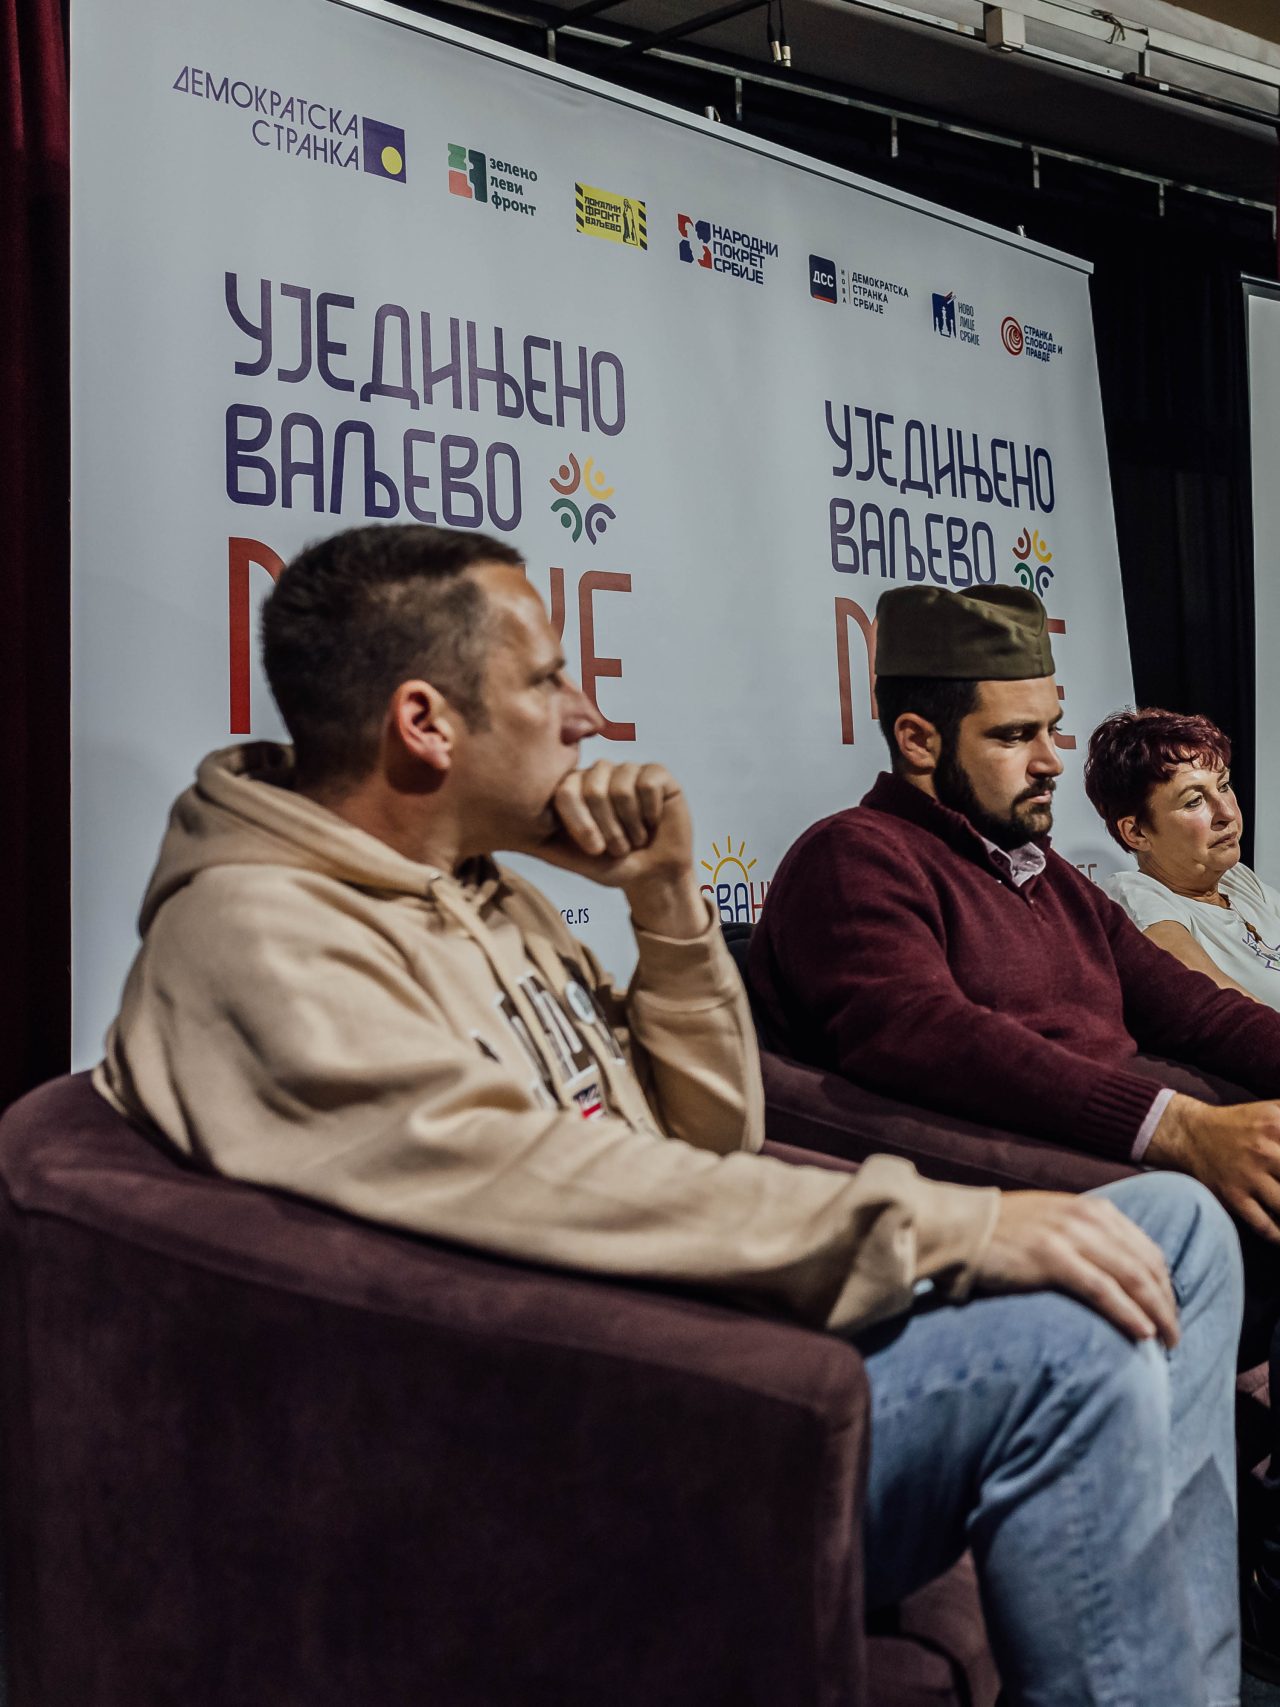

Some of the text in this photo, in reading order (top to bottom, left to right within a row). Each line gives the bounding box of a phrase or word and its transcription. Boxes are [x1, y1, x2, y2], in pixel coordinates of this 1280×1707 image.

[172, 65, 359, 140] ДЕМОКРАТСКА
[252, 119, 360, 171] СТРАНКА
[489, 157, 538, 182] зелено
[490, 175, 524, 196] леви
[491, 191, 537, 217] фронт
[585, 205, 621, 223] ФРОНТ
[585, 216, 622, 233] ВАЉЕВО
[712, 223, 779, 258] НАРОДНИ
[713, 240, 766, 269] ПОКРЕТ
[713, 257, 764, 286] СРБИЈЕ
[812, 270, 835, 288] ДСС
[851, 271, 909, 298] ДЕМОКРАТСКА
[852, 284, 889, 304] СТРАНКА
[853, 297, 884, 315] СРБИЈЕ
[958, 302, 975, 317] НОВО
[959, 316, 975, 332] ЛИЦЕ
[1023, 325, 1053, 342] СТРАНКА
[960, 329, 980, 346] СРБИЈЕ
[1024, 336, 1063, 355] СЛОБОДЕ И
[225, 271, 626, 437] УЈЕДИЊЕНО
[1025, 346, 1050, 363] ПРАВДЕ
[226, 403, 522, 532] ВАЉЕВО
[825, 400, 1055, 513] УЈЕДИЊЕНО
[829, 497, 996, 588] ВАЉЕВО
